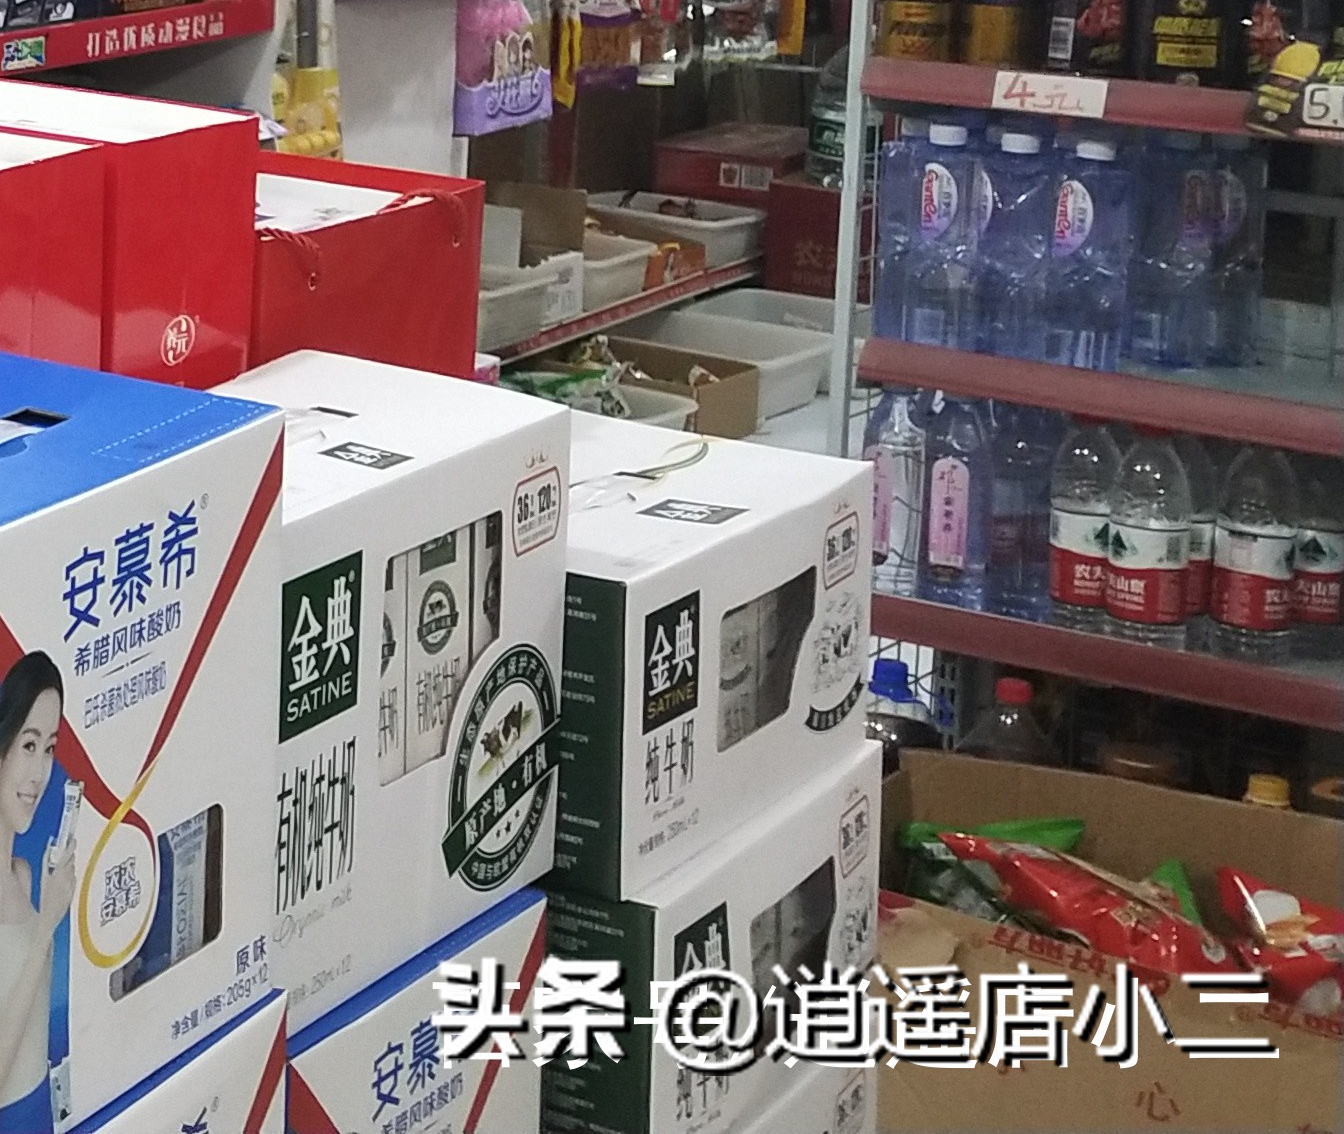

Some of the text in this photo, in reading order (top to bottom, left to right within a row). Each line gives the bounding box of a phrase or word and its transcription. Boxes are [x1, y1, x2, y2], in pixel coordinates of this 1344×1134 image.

[62, 499, 199, 643] 安慕希
[73, 601, 183, 678] 希腊风味酸奶
[286, 569, 356, 694] 金典
[647, 608, 696, 698] 金典
[286, 670, 353, 724] SATINE
[646, 681, 696, 721] SATINE
[274, 735, 358, 916] 有机纯牛奶
[235, 934, 268, 977] 原味
